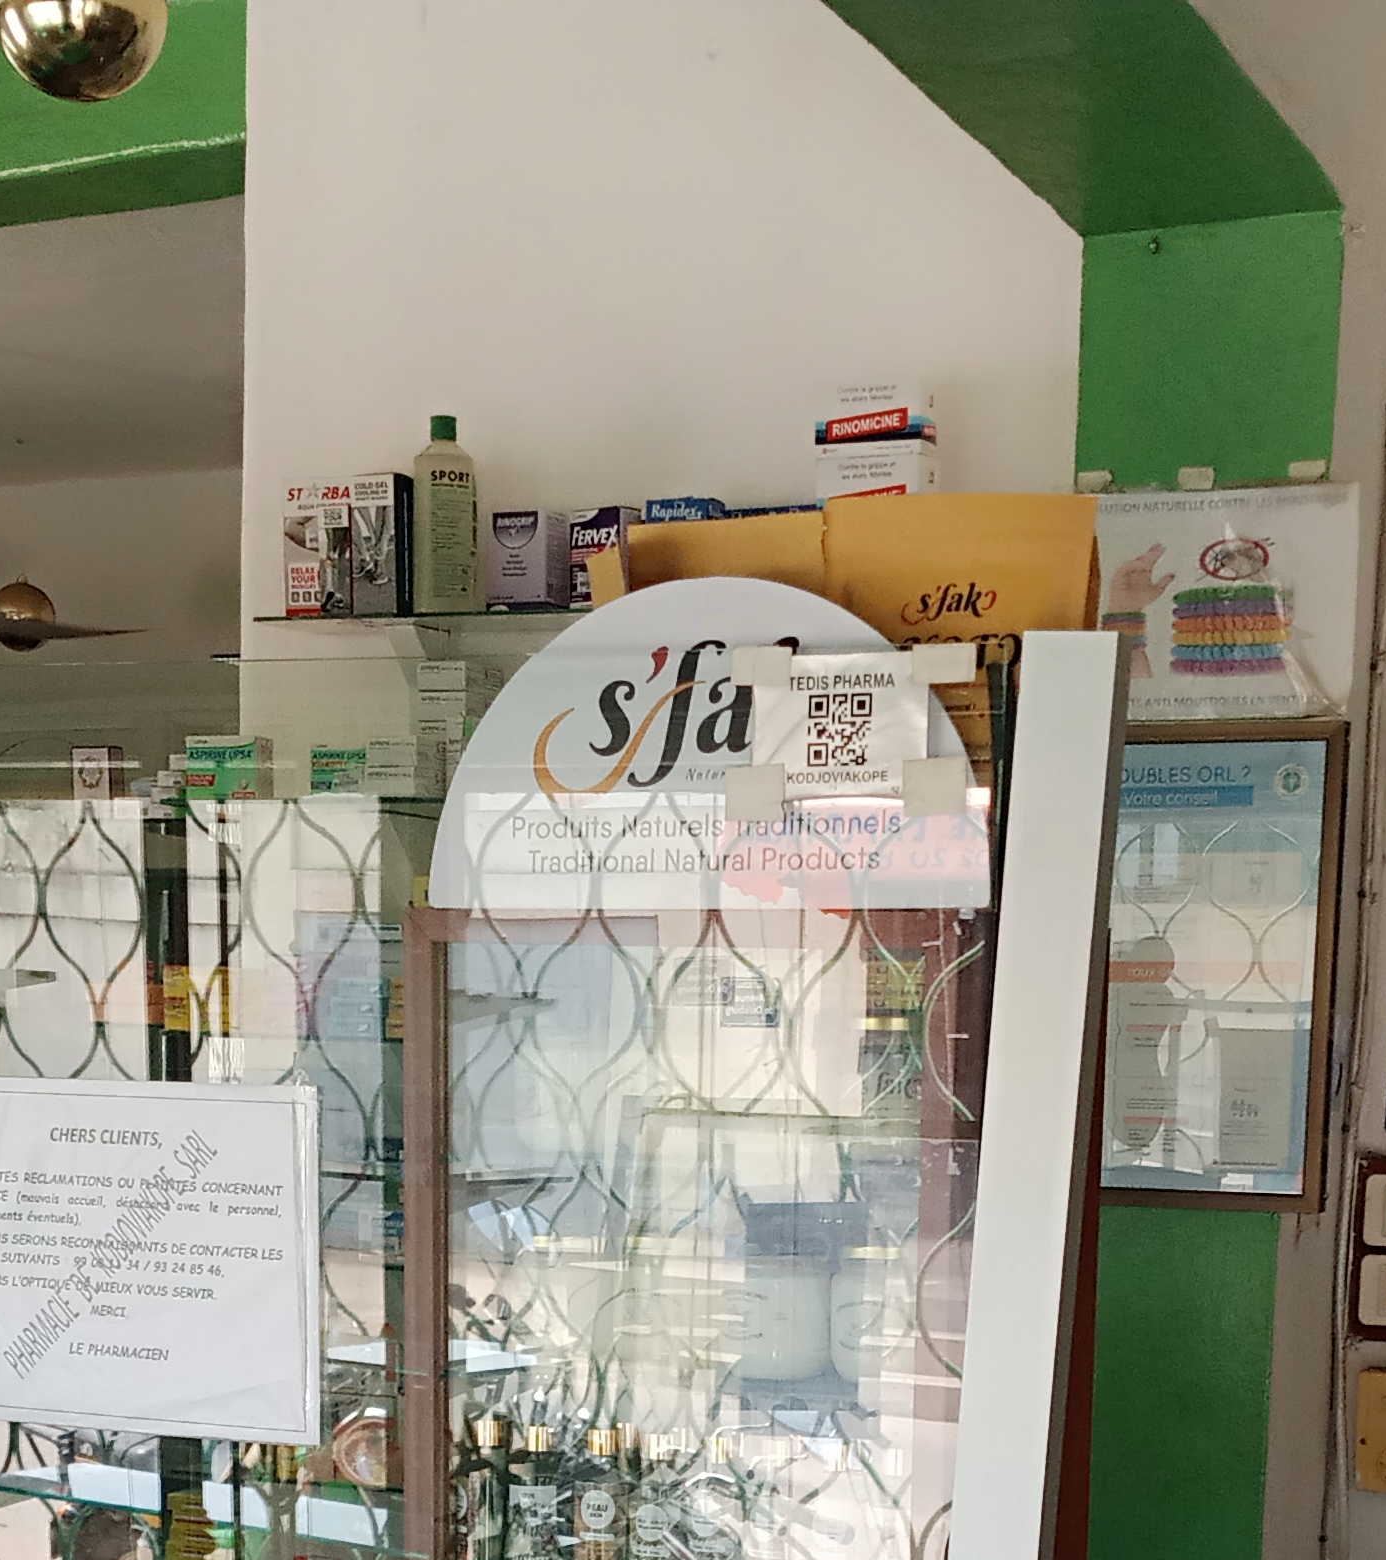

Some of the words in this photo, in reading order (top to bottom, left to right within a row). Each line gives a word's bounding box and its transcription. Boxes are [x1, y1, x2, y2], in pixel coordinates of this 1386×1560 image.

[833, 412, 901, 437] RINOMICINE
[431, 470, 470, 483] SPORT
[790, 675, 830, 692] TEDIS
[833, 672, 896, 689] PHARMA
[787, 770, 888, 785] KODJOVIAKOPE
[1197, 766, 1235, 784] ORL
[1124, 790, 1163, 806] Votre
[512, 816, 611, 841] Produits
[622, 816, 723, 840] Naturels
[736, 812, 901, 837] Traditionnels
[529, 850, 655, 874] Traditional
[665, 849, 752, 873] Natural
[762, 848, 881, 871] Products
[50, 1127, 97, 1144] CHERS
[100, 1129, 163, 1149] CLIENTS,
[24, 1172, 113, 1188] RECLAMATIONS
[117, 1177, 135, 1189] OU
[202, 1181, 284, 1197] CONCERNANT
[177, 1202, 201, 1212] avec
[210, 1201, 219, 1213] le
[2, 1288, 80, 1380] PHARMACIE
[173, 1129, 218, 1179] SARL
[11, 1233, 58, 1247] SERONS
[171, 1243, 186, 1255] DE
[190, 1244, 258, 1259] CONTACTER
[261, 1248, 284, 1261] LES
[1, 1252, 61, 1266] SUIVANTS
[74, 1256, 87, 1267] 99
[126, 1259, 140, 1271] 34
[153, 1261, 168, 1272] 93
[171, 1262, 186, 1273] 24
[190, 1264, 204, 1275] 85
[12, 1276, 71, 1291] L'OPTIQUE
[96, 1281, 133, 1294] MIEUX
[137, 1283, 169, 1297] VOUS
[69, 1342, 85, 1355] LE
[88, 1343, 170, 1361] PHARMACIEN
